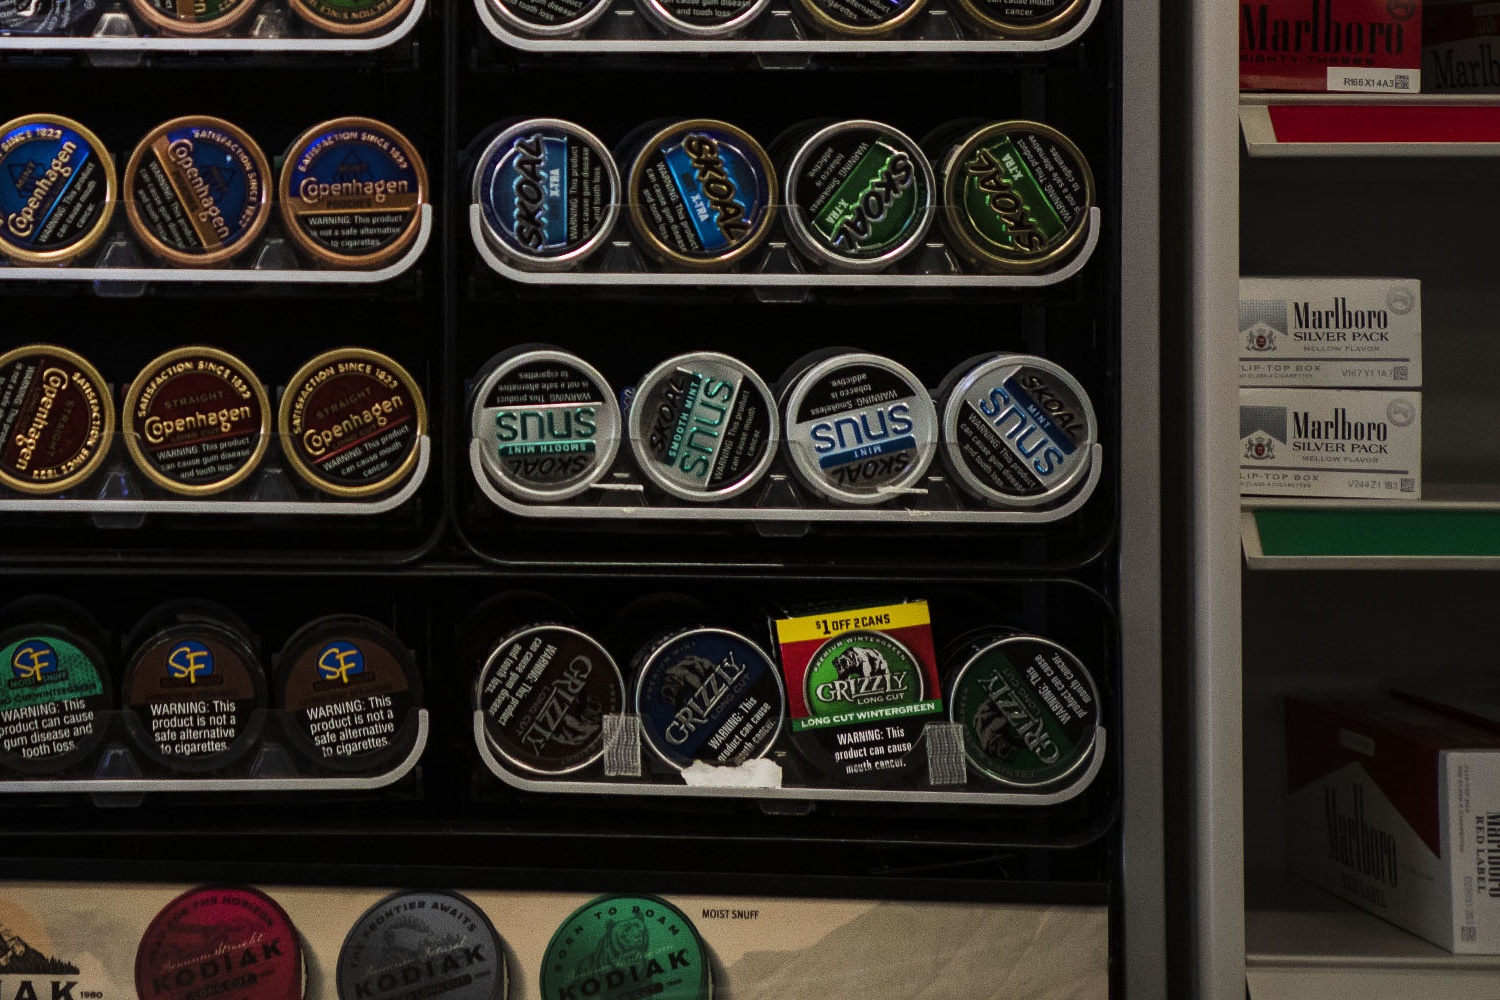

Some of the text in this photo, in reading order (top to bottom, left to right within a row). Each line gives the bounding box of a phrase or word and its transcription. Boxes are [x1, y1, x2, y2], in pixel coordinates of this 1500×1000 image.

[300, 177, 408, 207] Copenhagen
[1293, 297, 1388, 330] Marlboro
[1294, 331, 1389, 342] SILVER PACK
[138, 360, 252, 417] SATISFACTION SINCE 1822
[144, 405, 251, 444] Copenhagen
[304, 395, 403, 456] Copenhagen
[1293, 408, 1388, 441] Marlboro
[1293, 441, 1388, 454] SILVER PACK
[816, 619, 831, 635] $1
[832, 619, 851, 630] OFF
[861, 614, 891, 628] CANS
[168, 647, 213, 683] SF
[816, 671, 908, 702] GRIZZLY
[801, 702, 935, 728] LONG CUT WINTERGREEN
[702, 909, 759, 920] MOIST SNUFF
[559, 948, 691, 1000] KODIAK
